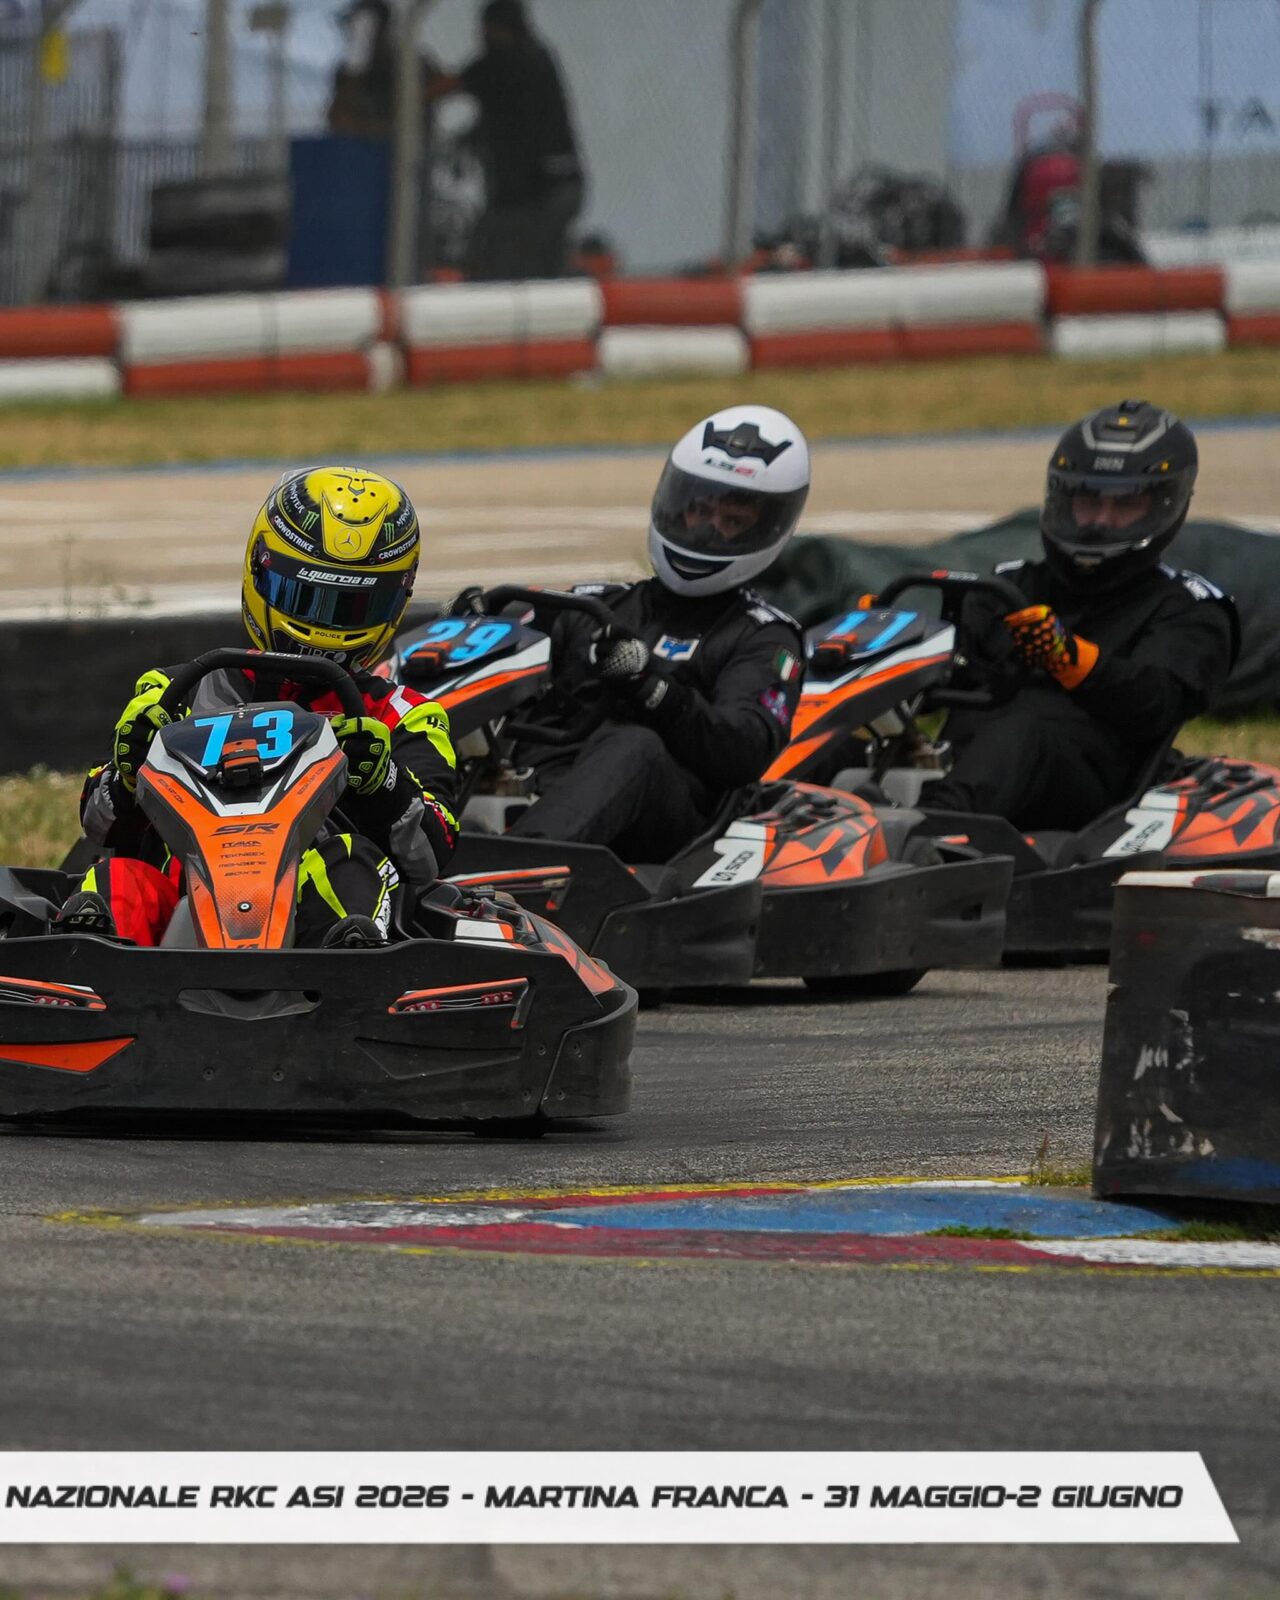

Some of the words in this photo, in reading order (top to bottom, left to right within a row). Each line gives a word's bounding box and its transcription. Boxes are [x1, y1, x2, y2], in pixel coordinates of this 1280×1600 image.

[274, 515, 315, 553] CROWDSTRIKE
[308, 570, 362, 584] quercia
[314, 630, 342, 640] POLICE
[401, 619, 513, 662] 29
[194, 709, 294, 768] 73
[209, 822, 281, 837] SR
